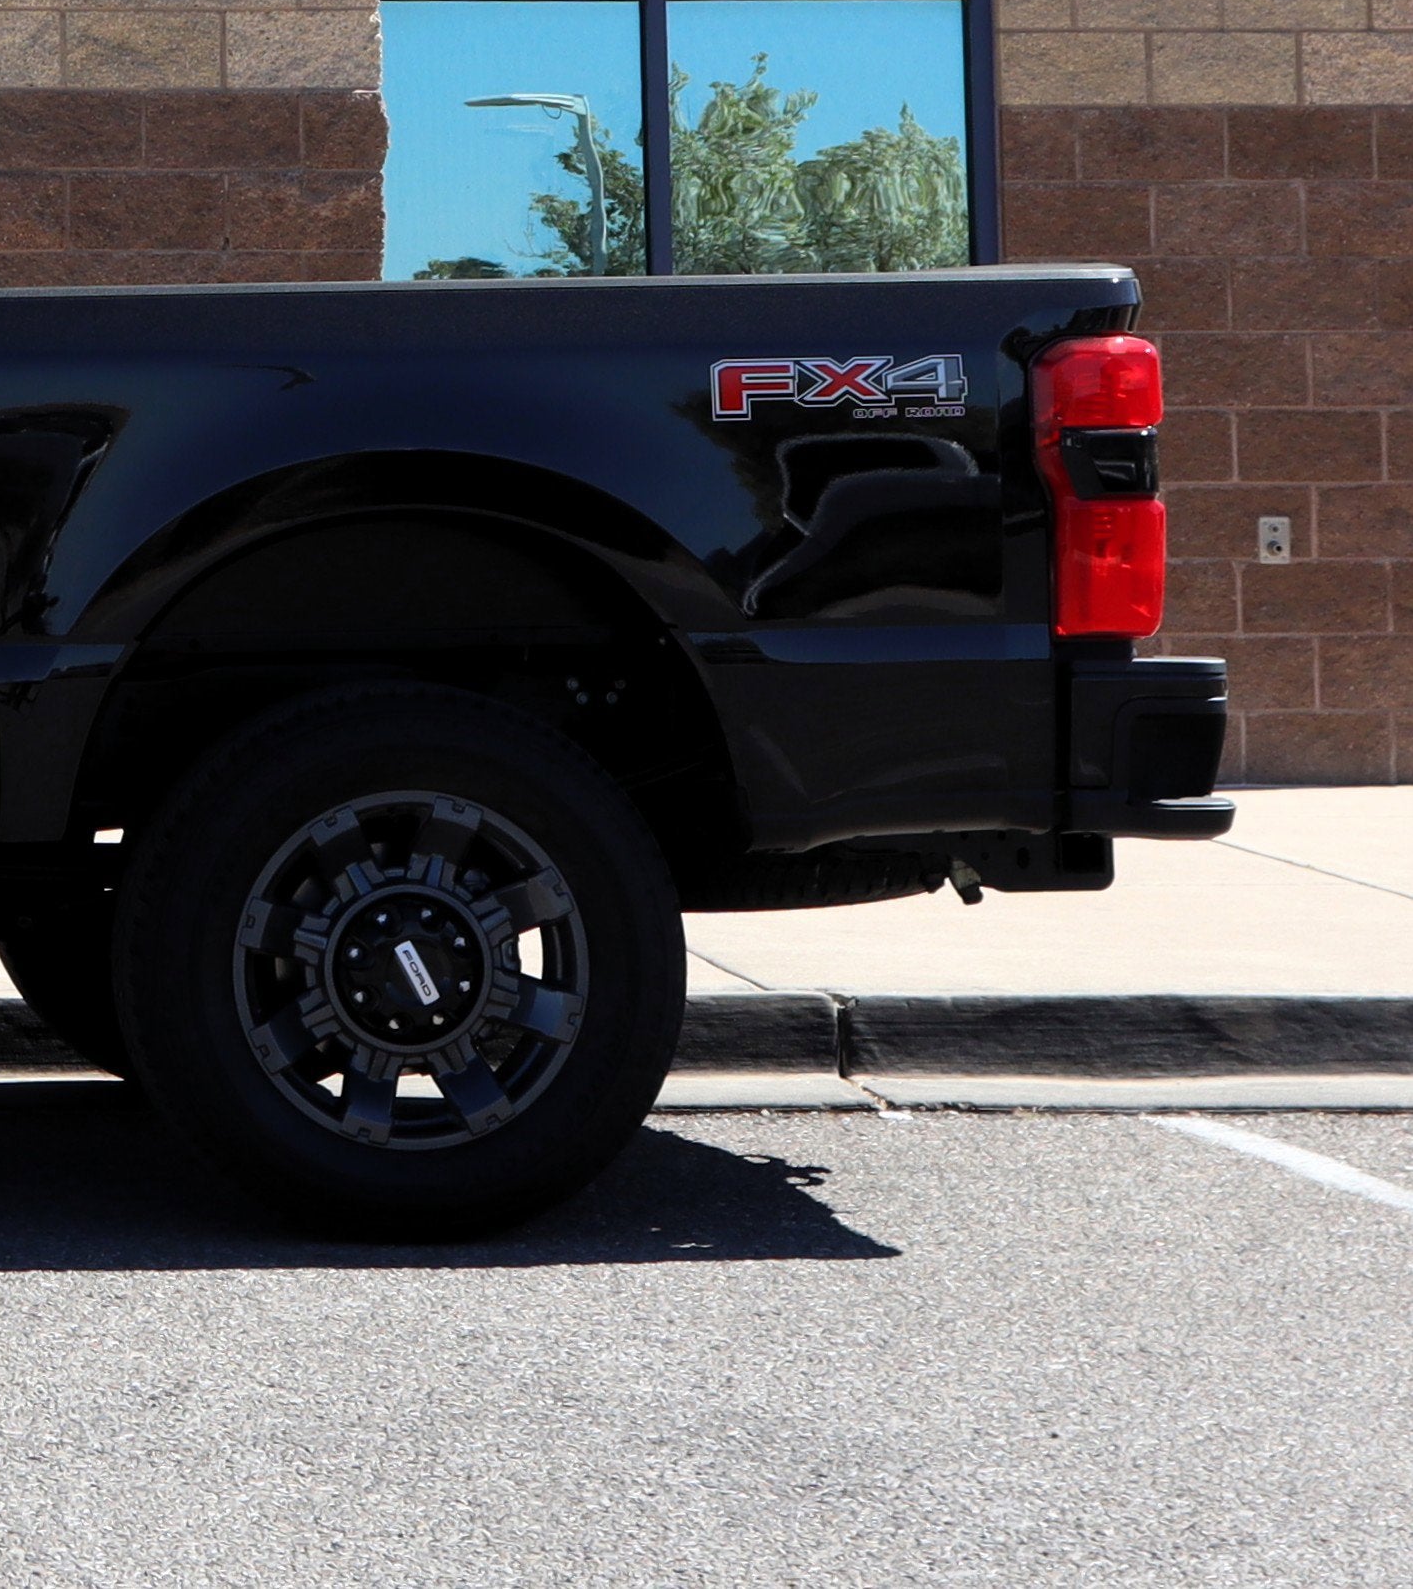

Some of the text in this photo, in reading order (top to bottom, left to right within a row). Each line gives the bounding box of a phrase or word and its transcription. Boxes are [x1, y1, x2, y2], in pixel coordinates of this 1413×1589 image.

[710, 354, 968, 421] FX4
[853, 406, 966, 418] OFF ROAD
[402, 950, 432, 997] FORD
